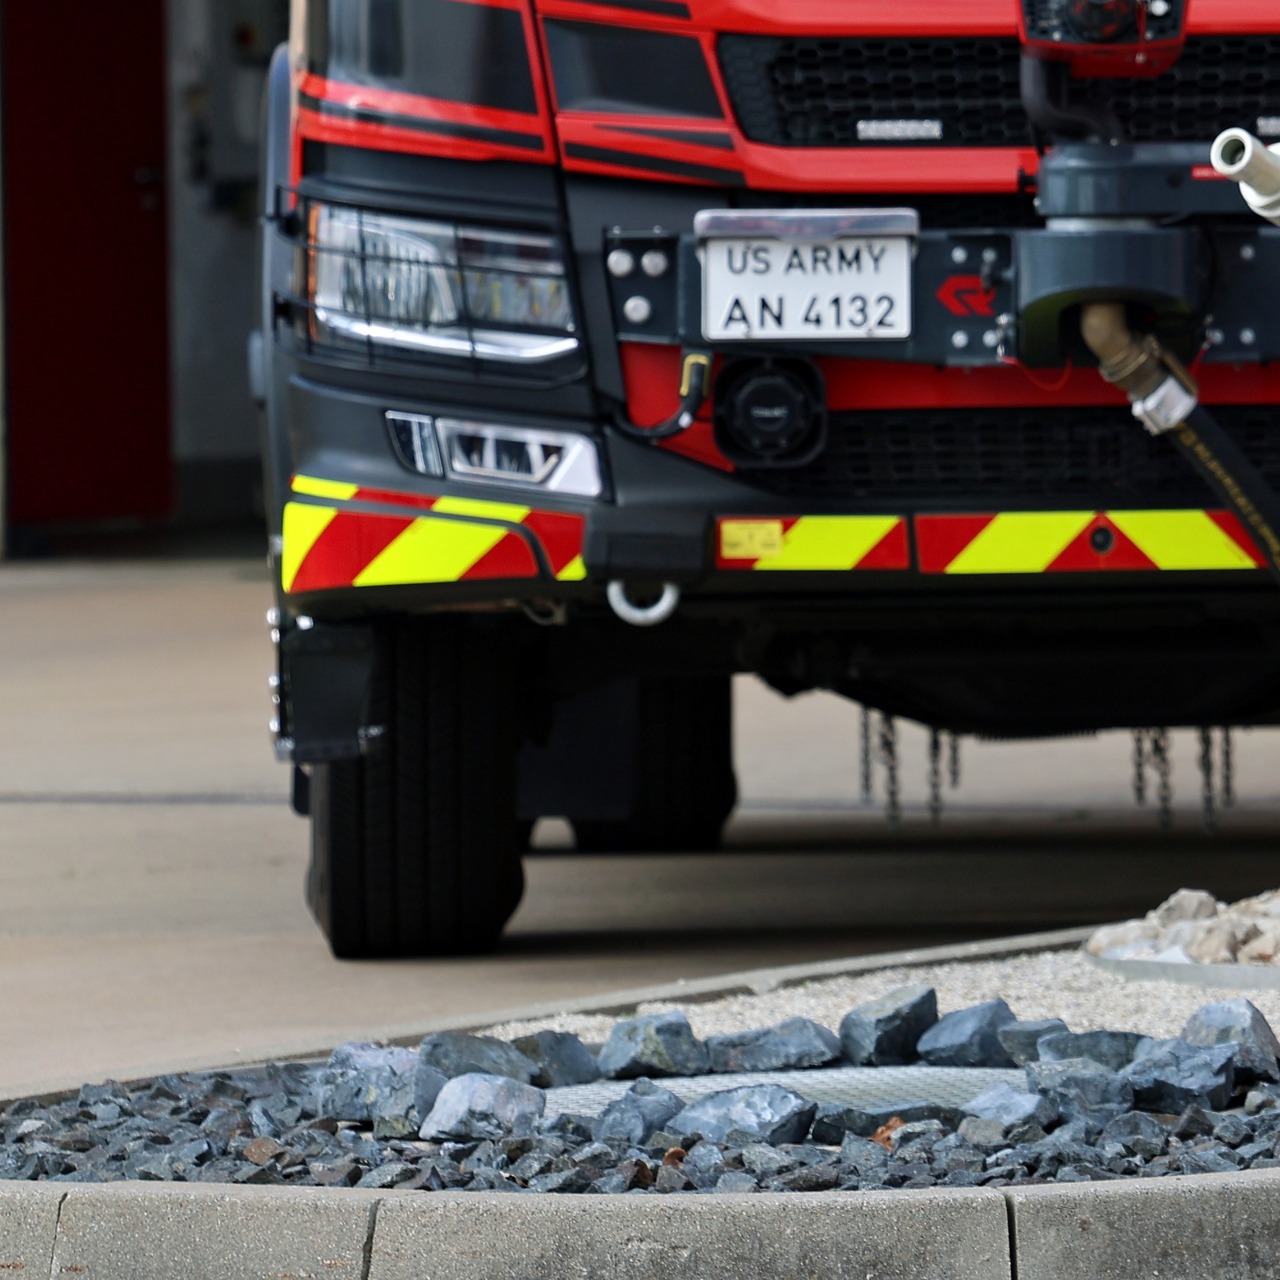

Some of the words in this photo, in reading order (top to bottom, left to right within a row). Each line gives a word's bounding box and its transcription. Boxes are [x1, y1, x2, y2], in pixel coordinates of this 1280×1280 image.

[727, 246, 770, 274] US
[784, 245, 886, 273] ARMY
[723, 296, 784, 328] AN
[803, 295, 894, 328] 4132
